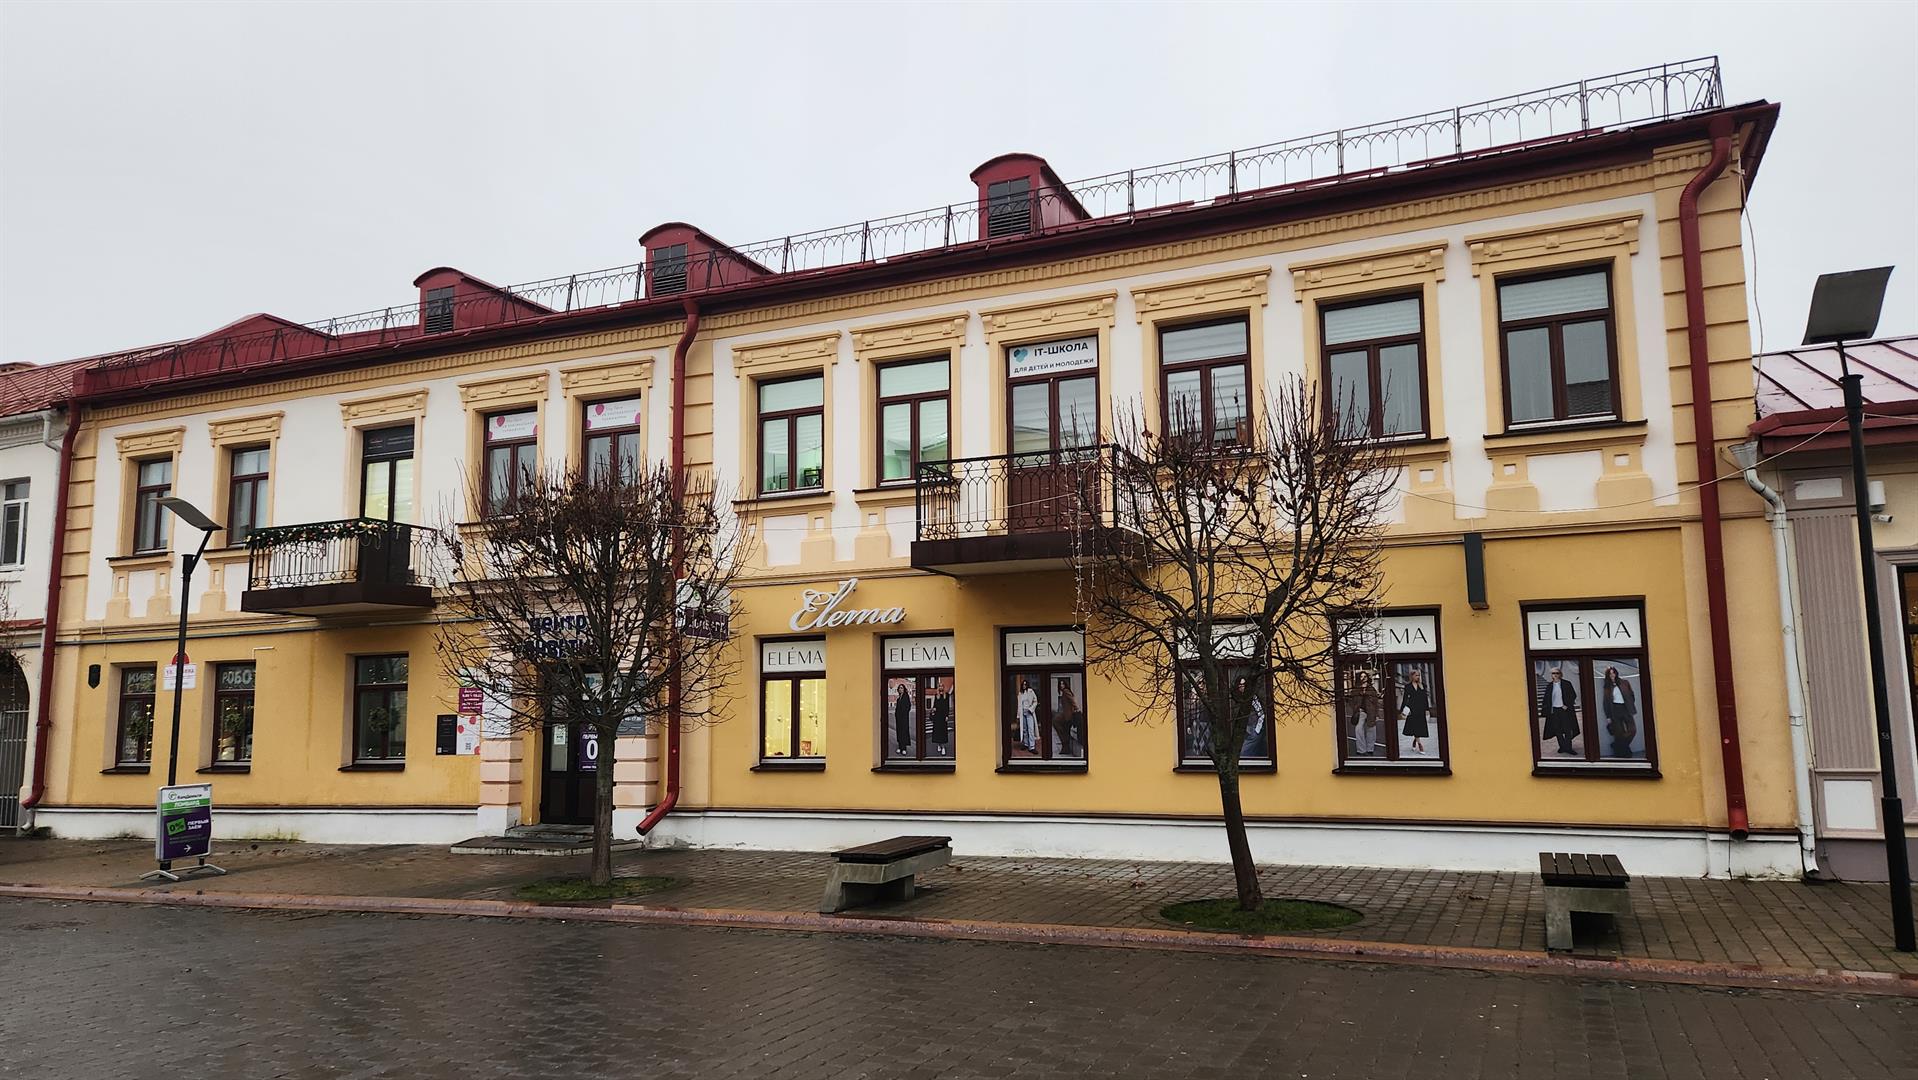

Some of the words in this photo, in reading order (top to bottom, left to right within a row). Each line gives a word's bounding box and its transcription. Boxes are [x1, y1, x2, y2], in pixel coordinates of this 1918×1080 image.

[1034, 342, 1088, 357] IT-ШКОЛА
[1028, 363, 1049, 372] ДЕТЕЙ
[1055, 358, 1094, 367] МОЛОДЕЖИ
[789, 577, 907, 632] Elema
[1537, 616, 1632, 641] ELÉMA
[768, 647, 824, 666] ELÉMA
[889, 643, 950, 663] ELÉMA
[1011, 638, 1078, 658] ELÉMA
[222, 669, 254, 685] РОБО
